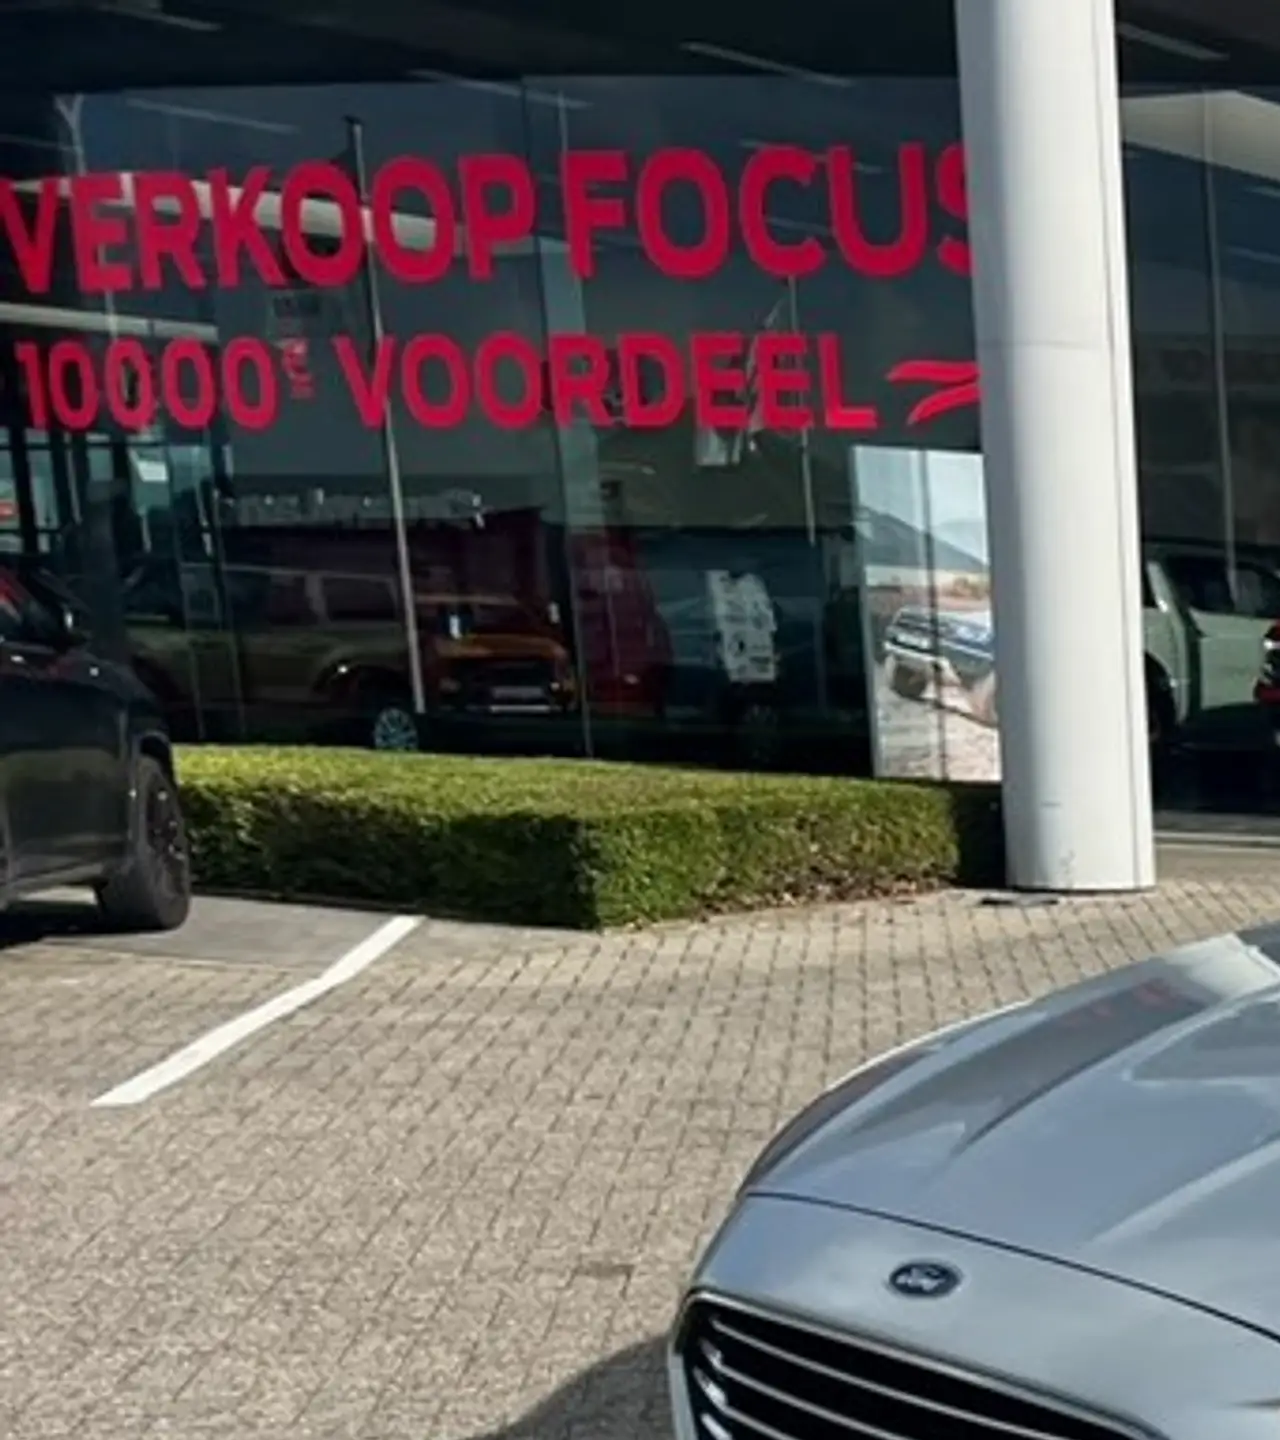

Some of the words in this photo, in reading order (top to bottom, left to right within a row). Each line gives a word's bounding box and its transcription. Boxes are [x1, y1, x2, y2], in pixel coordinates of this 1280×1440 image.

[0, 153, 536, 293] VERKOOP
[15, 335, 279, 433] 10000
[331, 331, 878, 430] VOORDEEL
